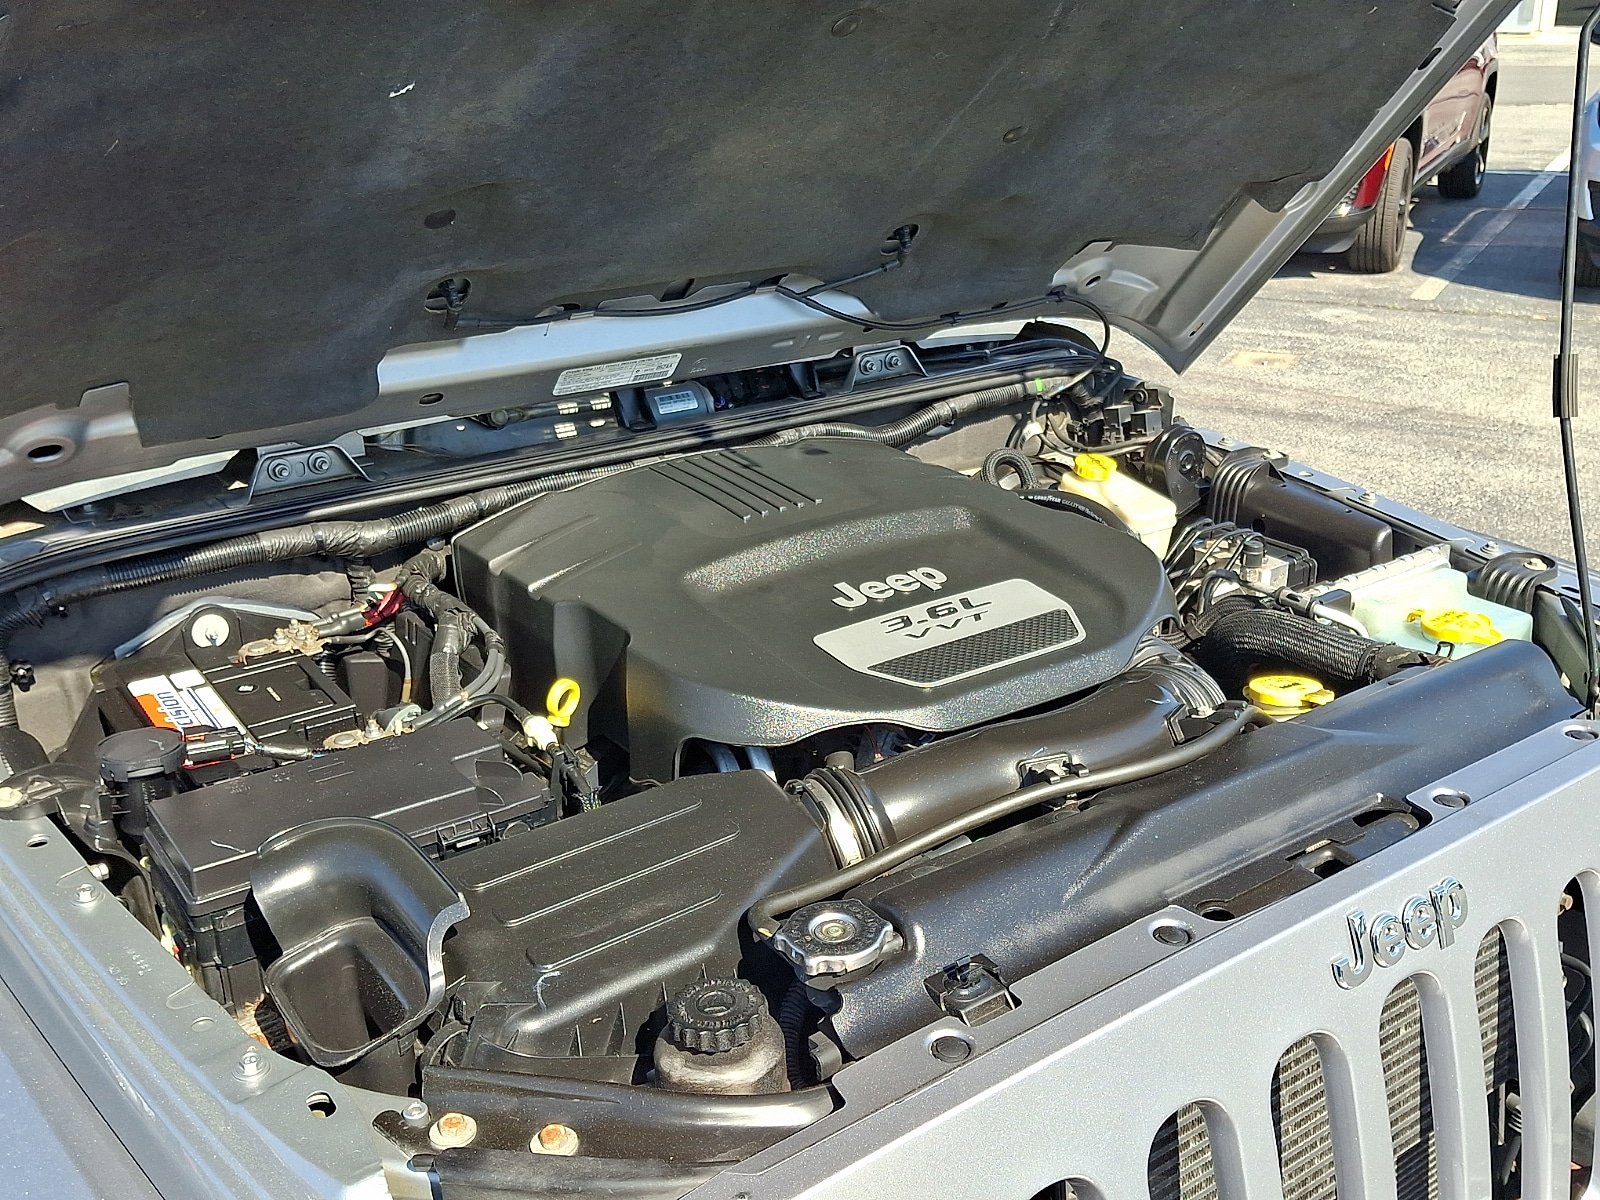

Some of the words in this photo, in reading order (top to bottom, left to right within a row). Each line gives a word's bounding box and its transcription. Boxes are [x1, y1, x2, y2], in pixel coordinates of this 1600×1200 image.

[832, 566, 948, 608] Jeep
[880, 597, 992, 634] 3.6L
[904, 610, 989, 639] VVT
[1330, 875, 1469, 991] Jeep
